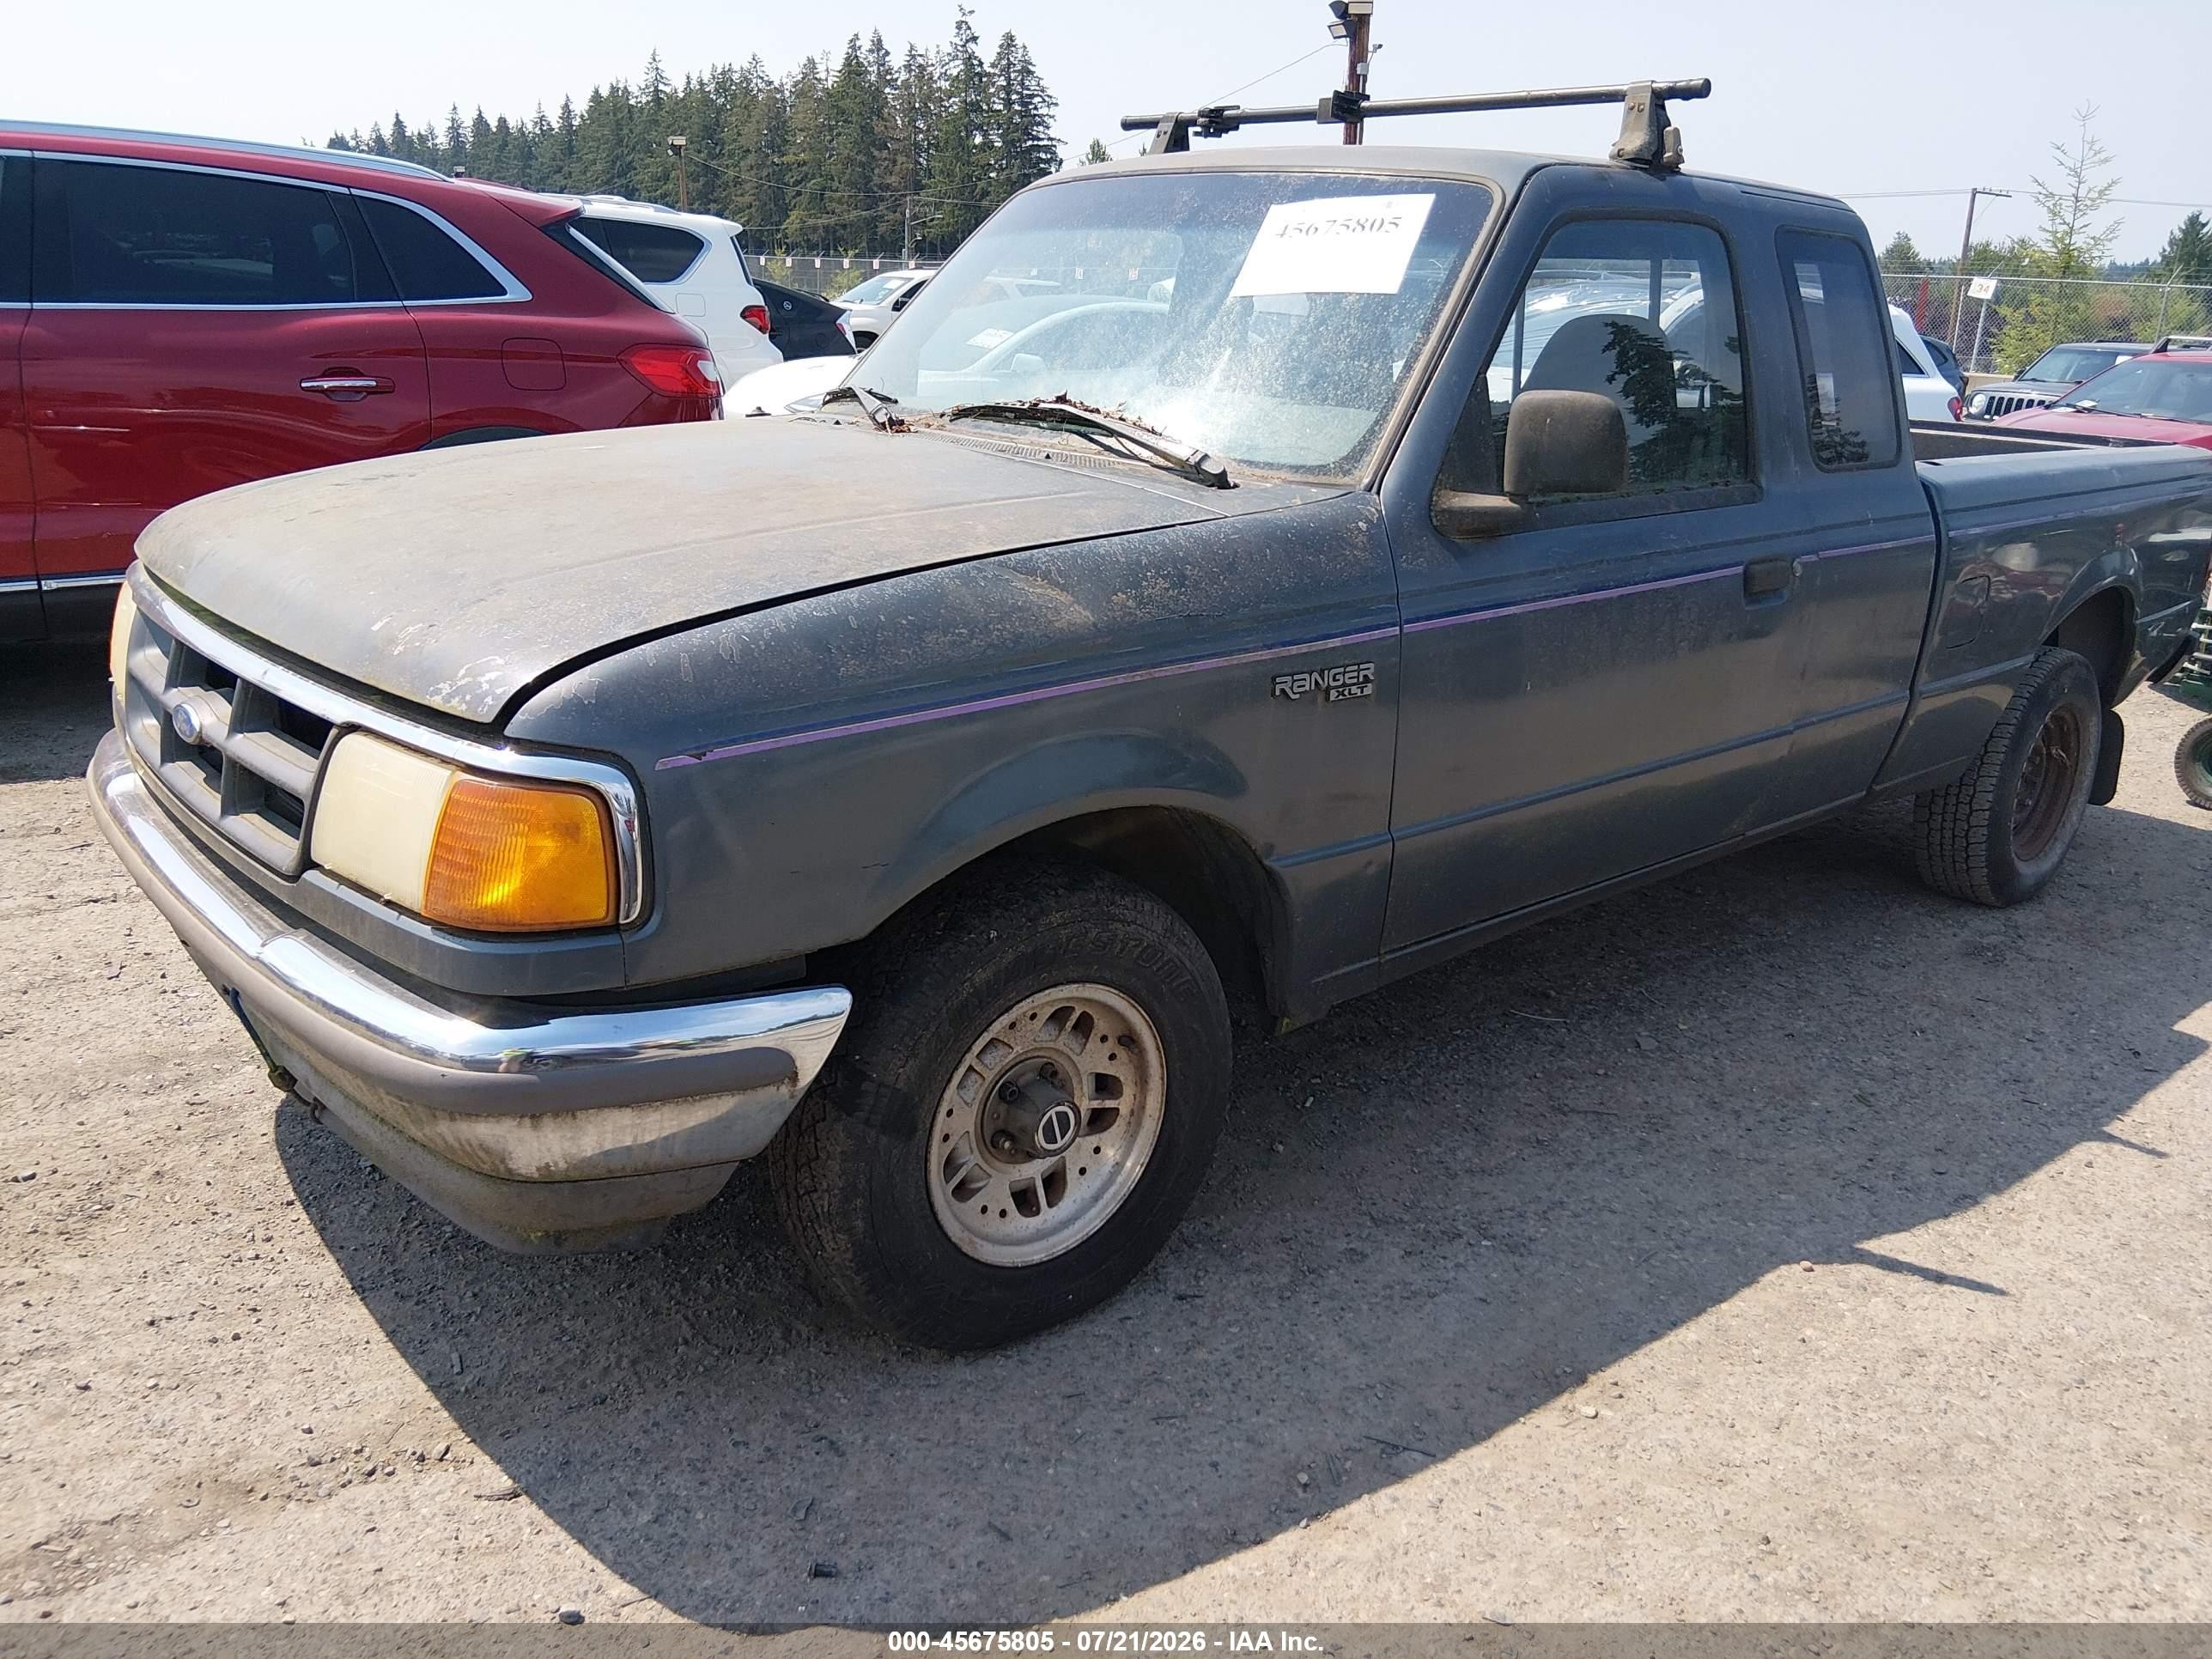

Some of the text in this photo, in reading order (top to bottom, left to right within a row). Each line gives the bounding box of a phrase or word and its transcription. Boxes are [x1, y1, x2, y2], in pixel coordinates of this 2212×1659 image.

[1275, 216, 1402, 239] 45675805
[1977, 283, 1990, 294] 34
[1273, 662, 1375, 700] RANGER
[1334, 684, 1368, 699] XLT
